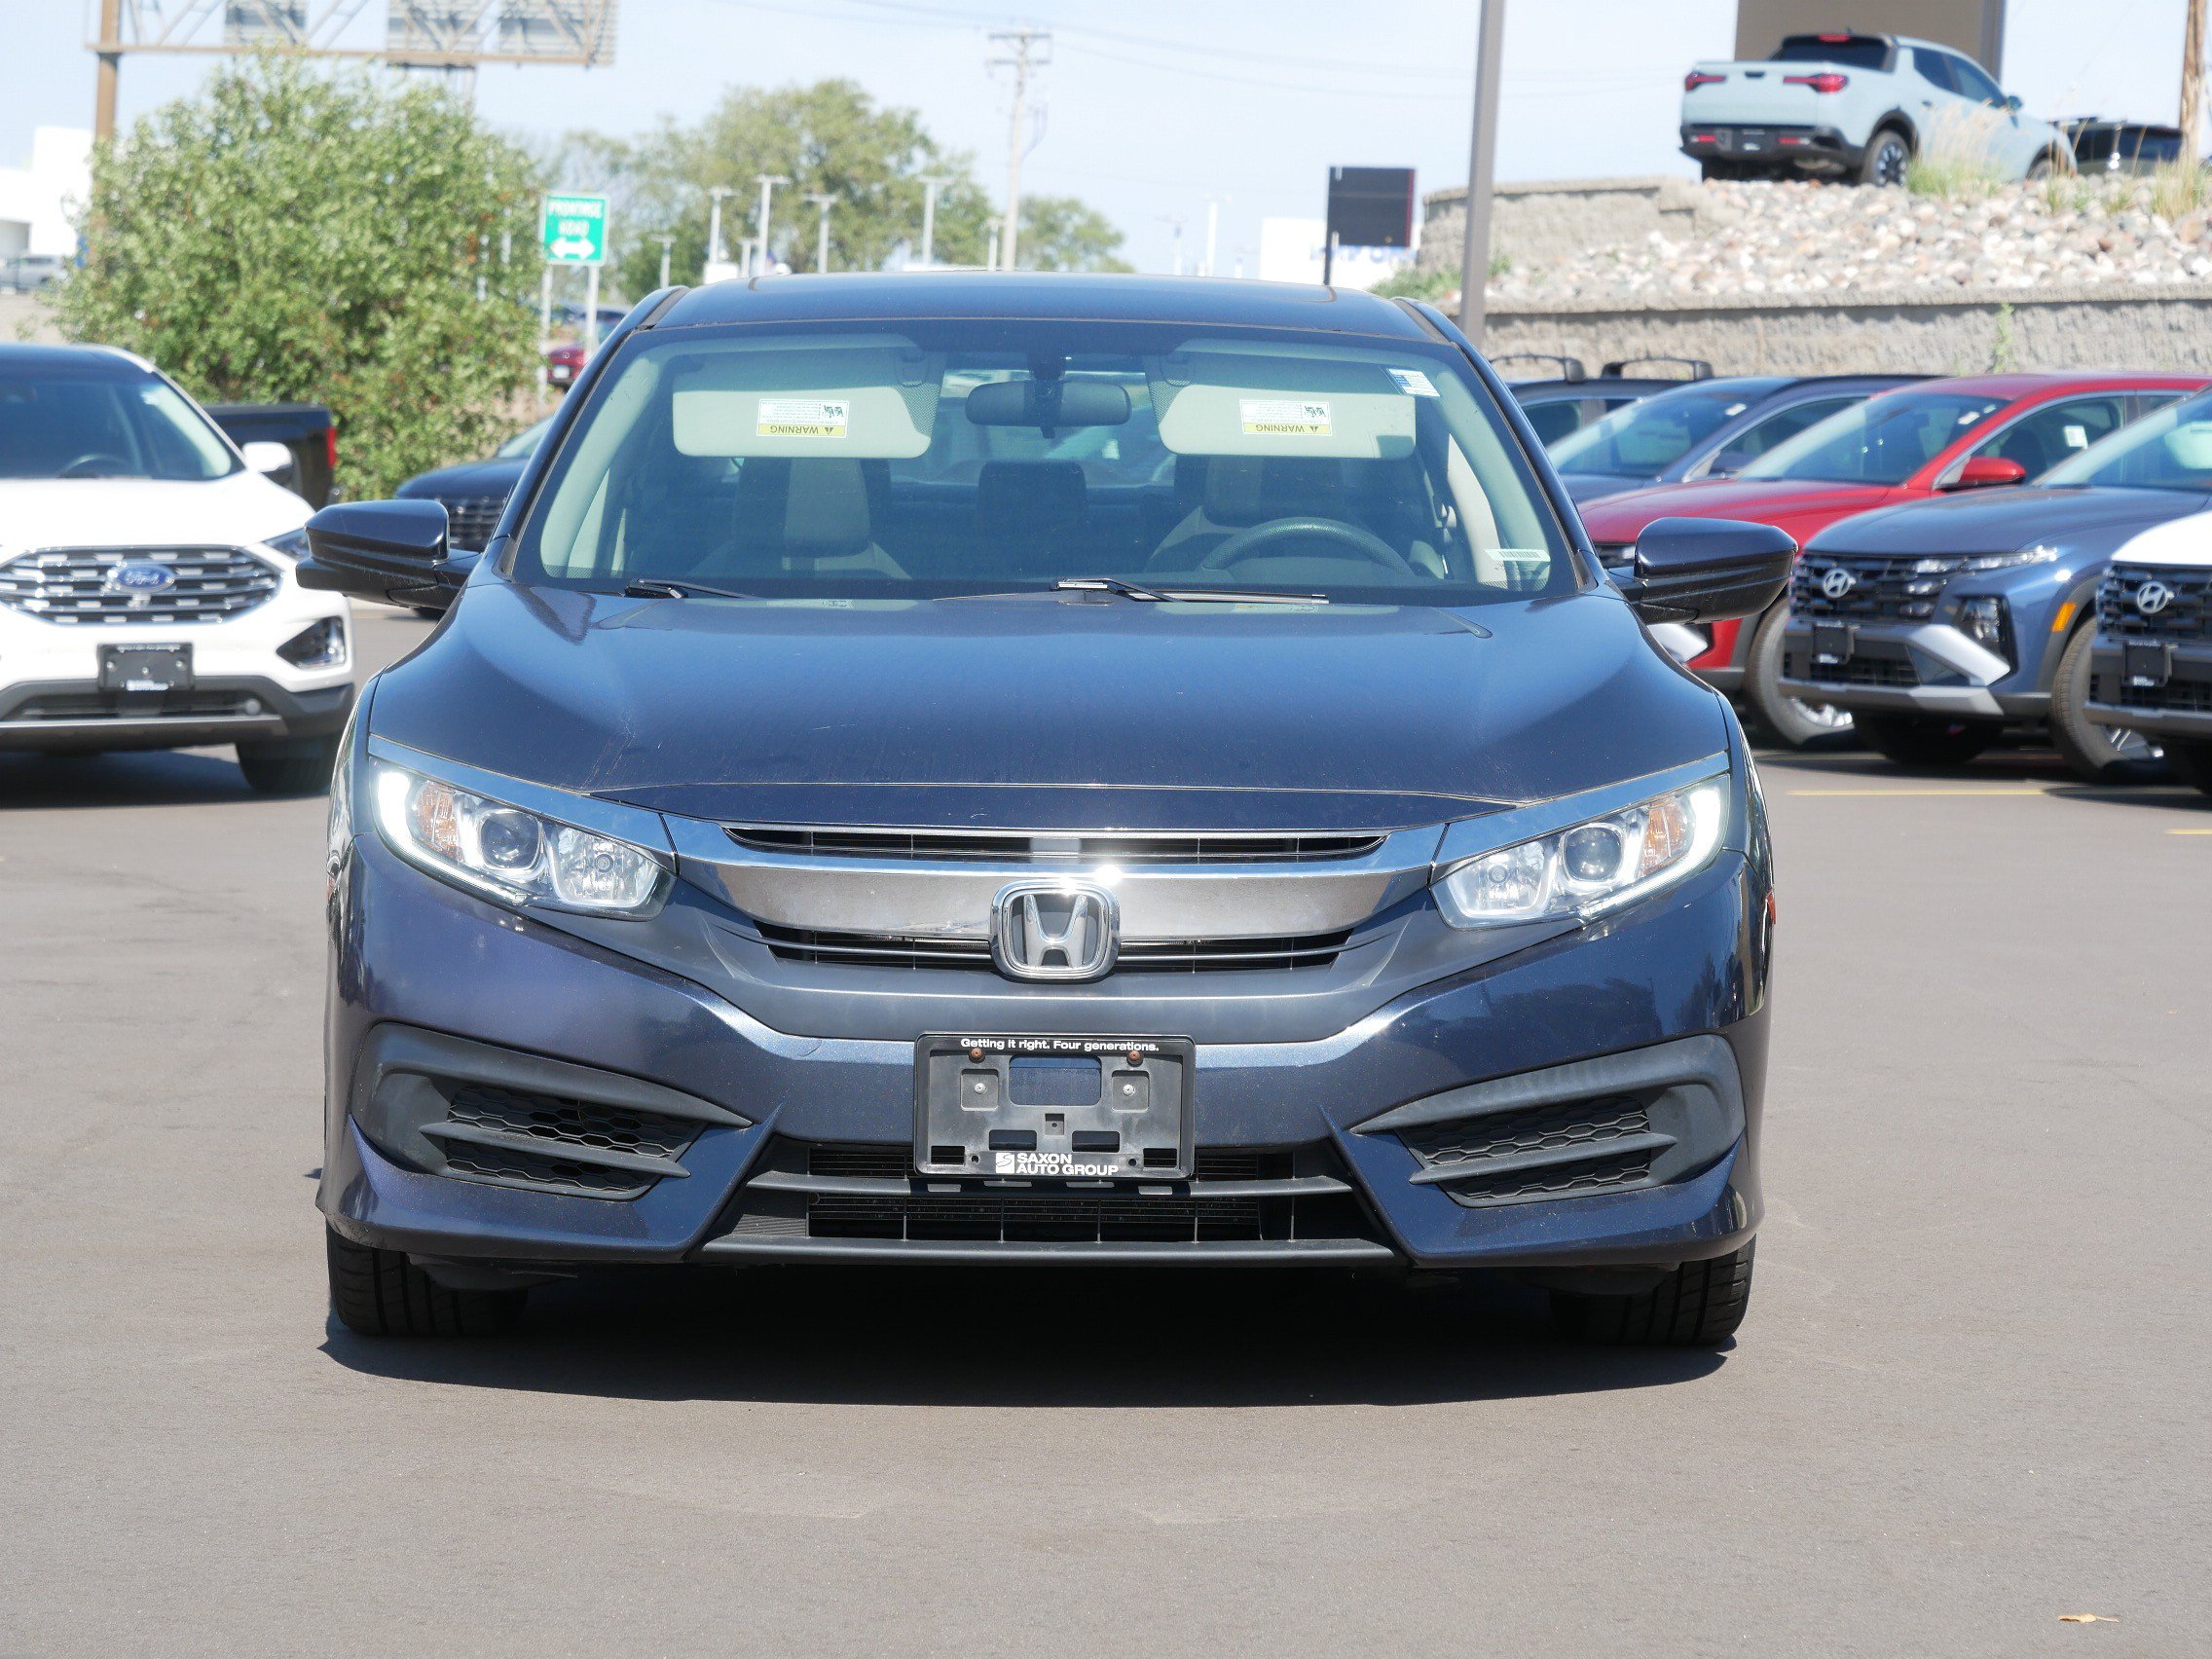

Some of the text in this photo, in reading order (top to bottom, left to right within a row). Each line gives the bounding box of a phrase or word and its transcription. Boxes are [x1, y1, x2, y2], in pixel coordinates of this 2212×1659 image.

[770, 425, 819, 434] WARNING
[1256, 424, 1305, 432] WARNING
[960, 1038, 1160, 1051] Getting it right. Four generations.
[1016, 1153, 1072, 1164] SAXON
[1016, 1163, 1119, 1176] AUTO GROUP
